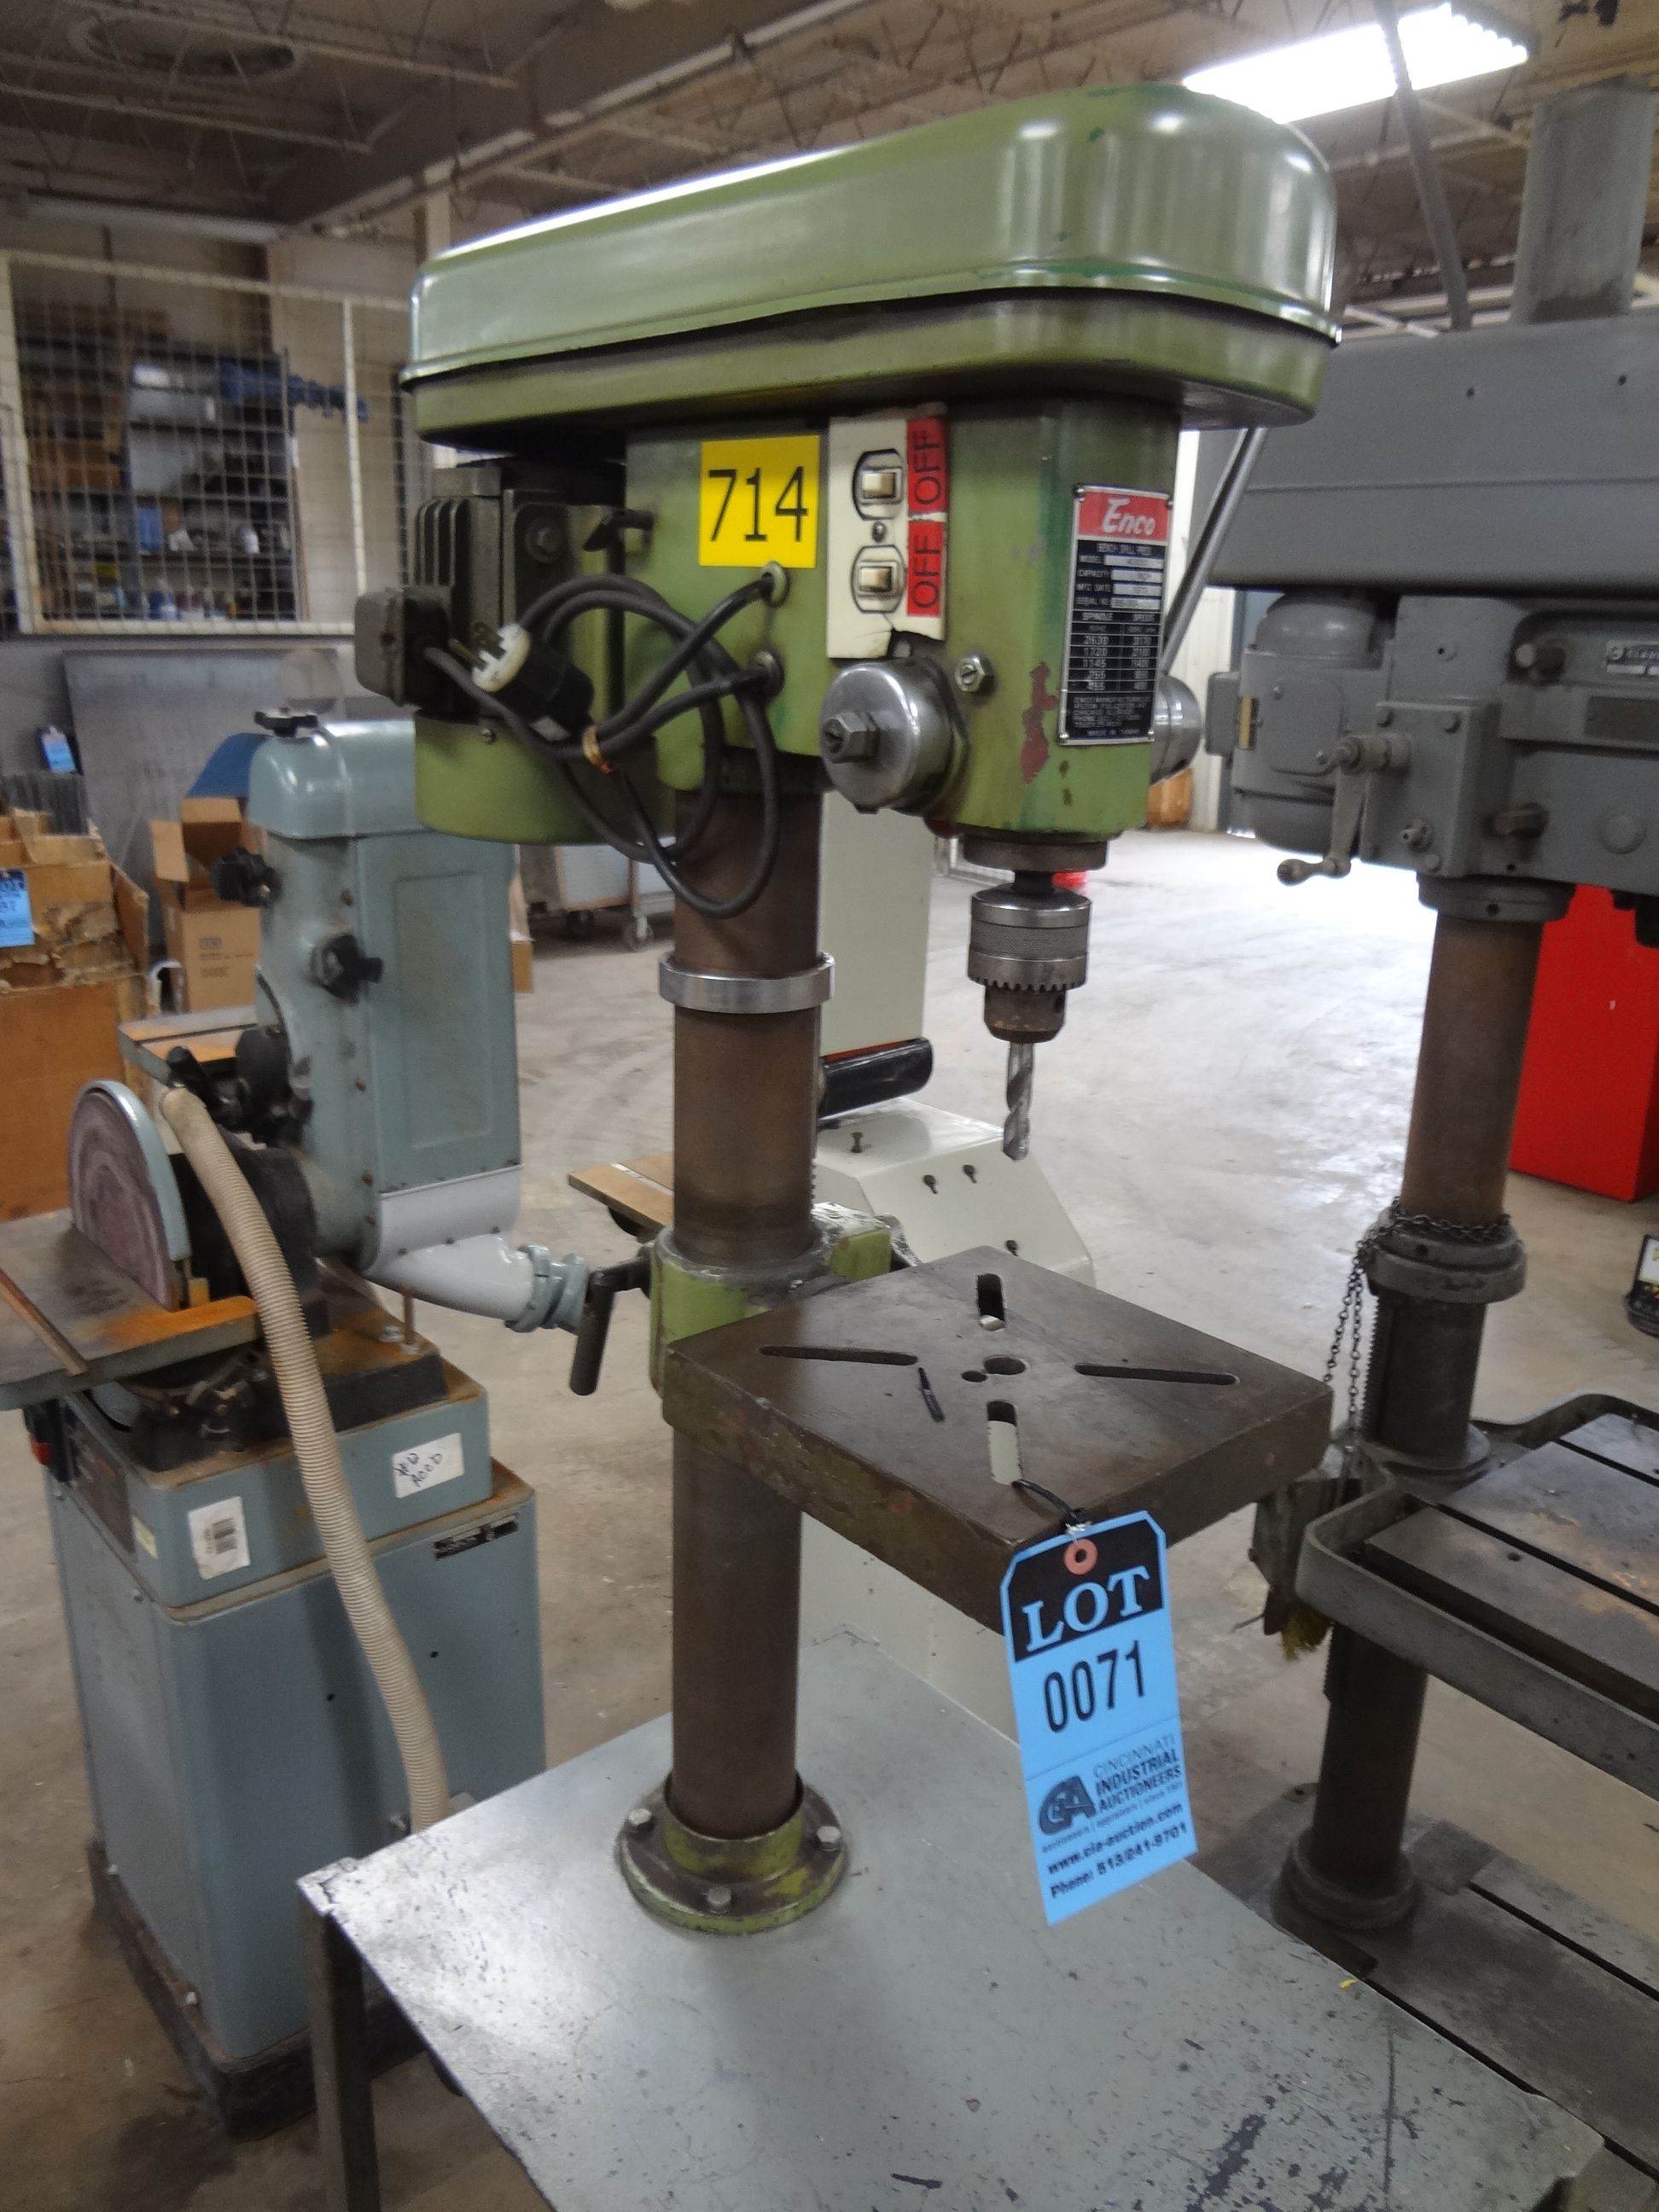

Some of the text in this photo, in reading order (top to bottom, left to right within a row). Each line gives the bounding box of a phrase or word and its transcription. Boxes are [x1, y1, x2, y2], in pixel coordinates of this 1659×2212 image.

[914, 429, 940, 505] OFF
[708, 466, 808, 542] 714
[1101, 498, 1156, 536] Enco
[913, 534, 940, 608] OFF
[1022, 1565, 1150, 1653] LOT
[1043, 1639, 1145, 1734] 0071
[1092, 1734, 1176, 1778] CINCINNATI
[1095, 1749, 1179, 1796] INDUSTRIAL
[1098, 1765, 1181, 1812] AUCTIONEERS
[1048, 1802, 1183, 1875] www.cia-auction.com
